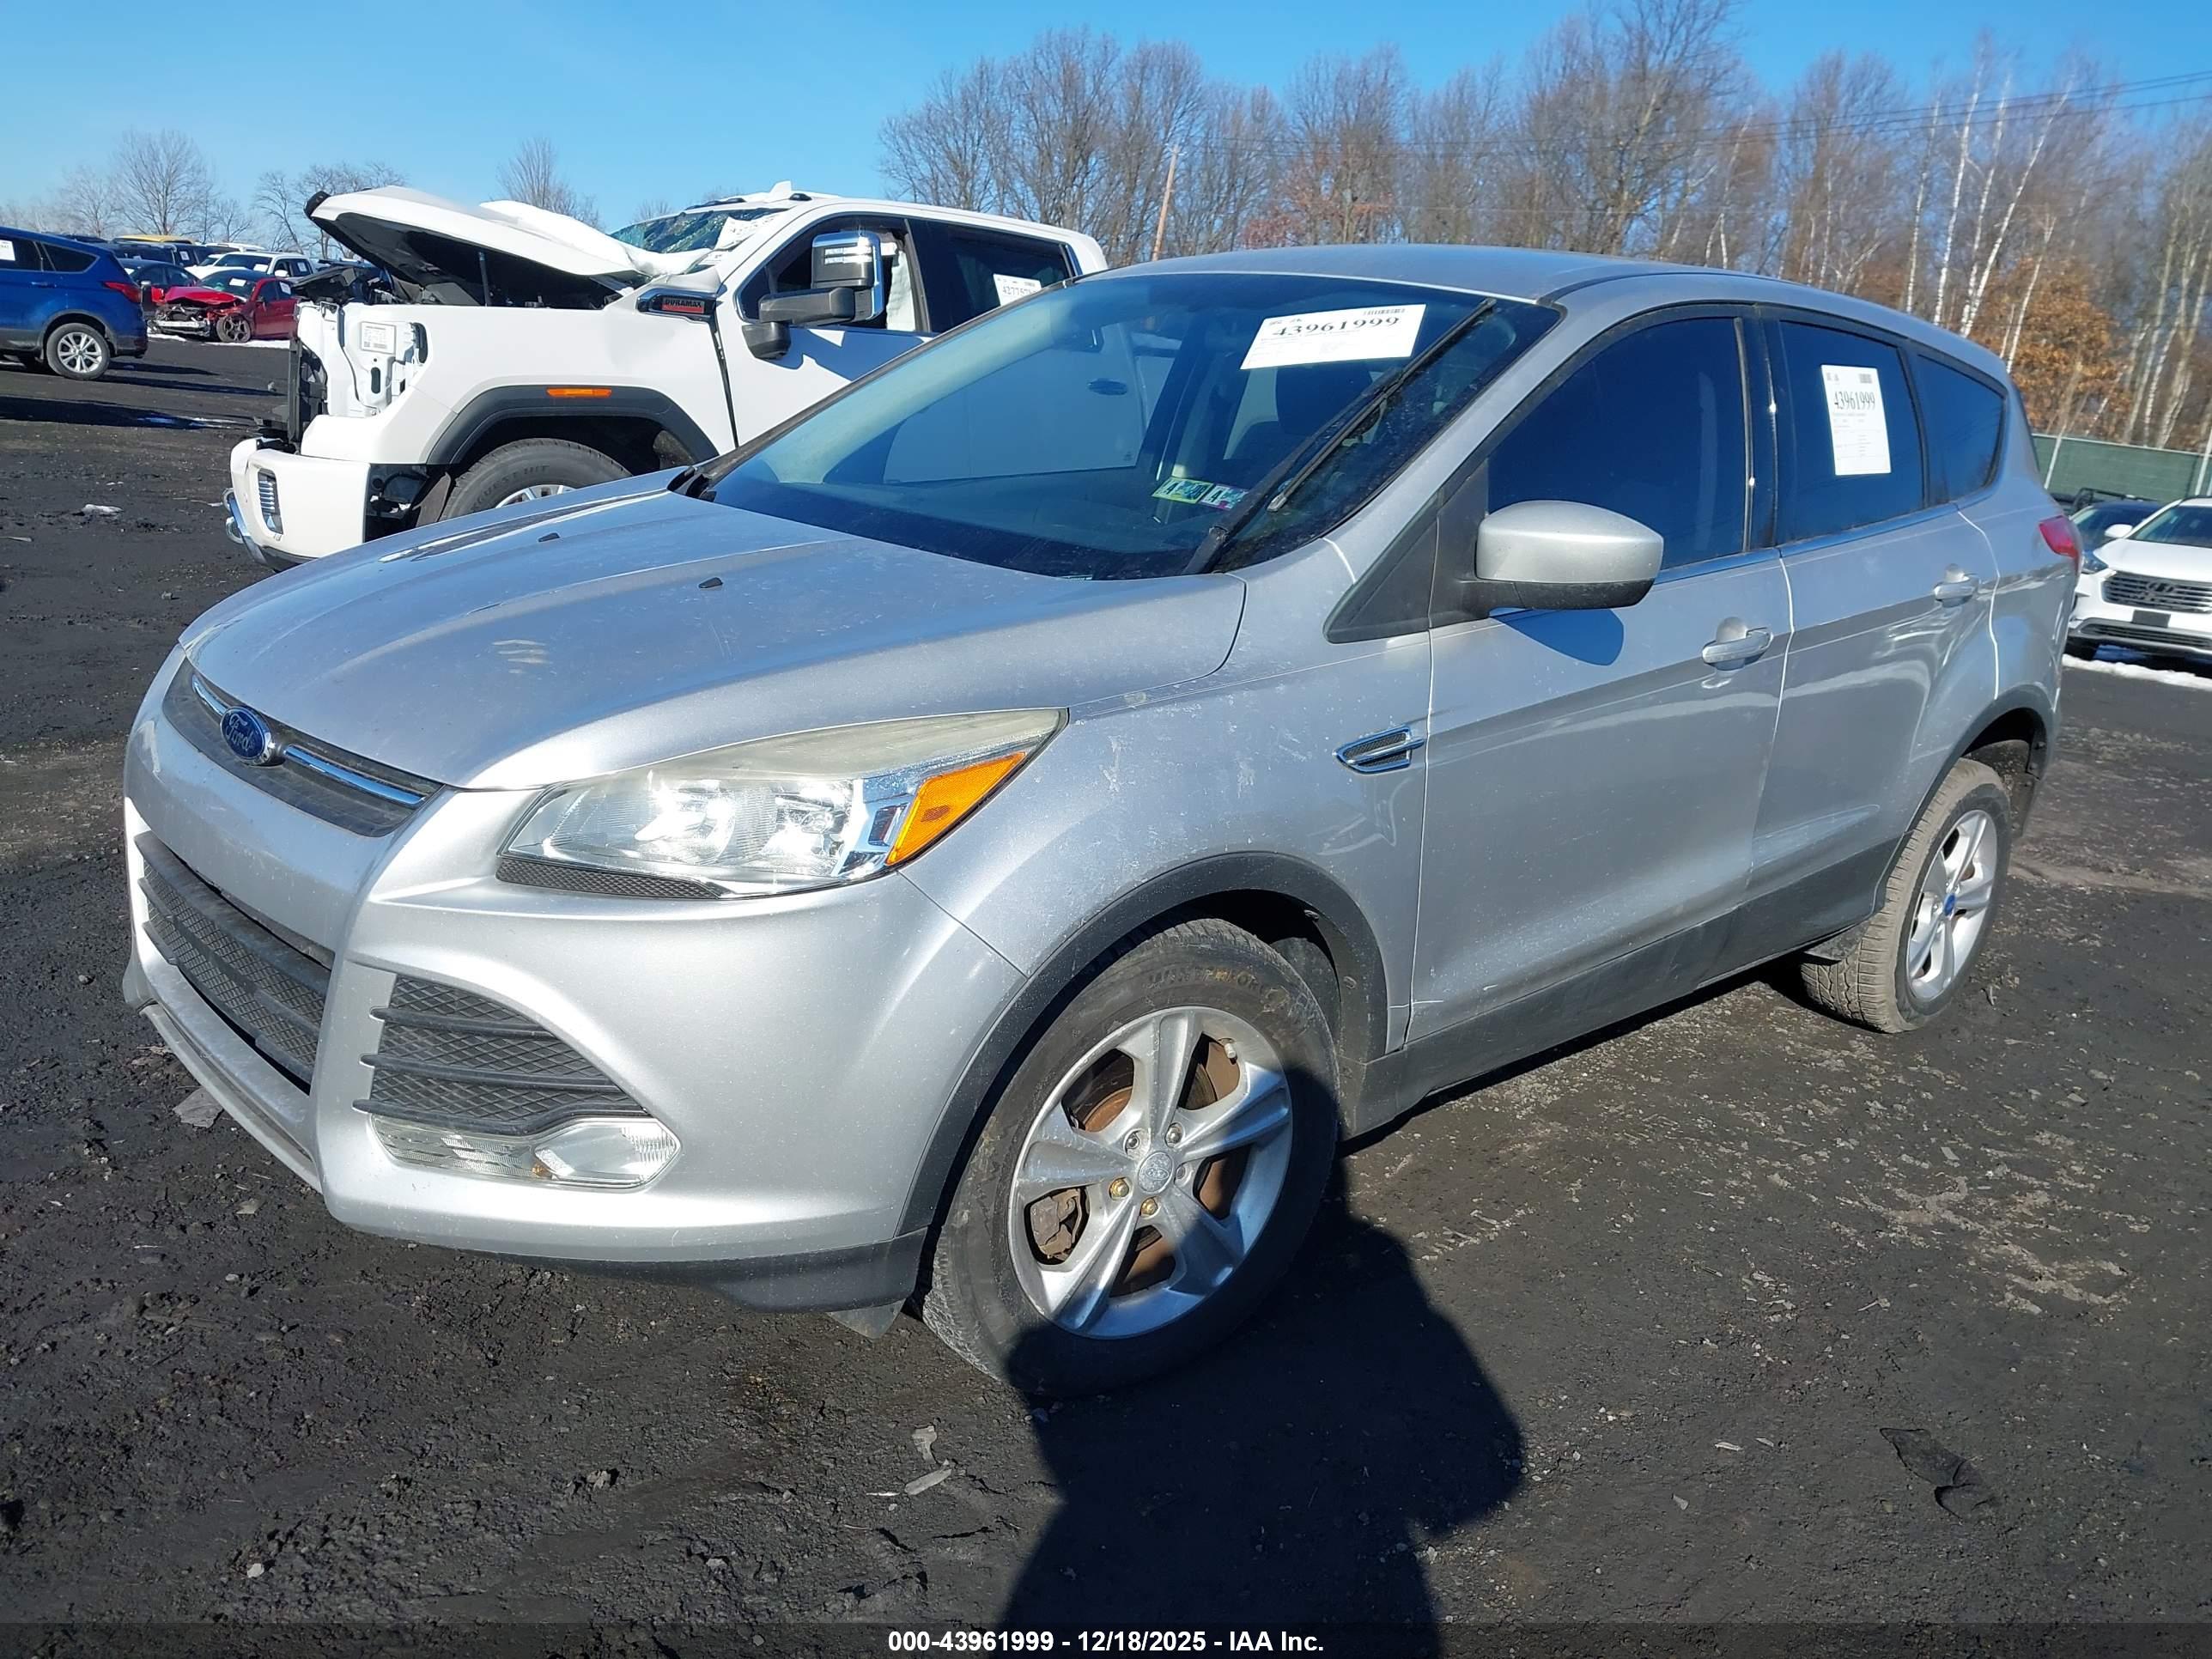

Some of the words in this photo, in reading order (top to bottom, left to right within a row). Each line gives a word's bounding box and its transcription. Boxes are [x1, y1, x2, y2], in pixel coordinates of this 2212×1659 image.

[665, 298, 702, 308] DURAMAX
[1272, 316, 1401, 336] 43961999
[1834, 391, 1875, 410] 43961999
[224, 713, 254, 751] Ford
